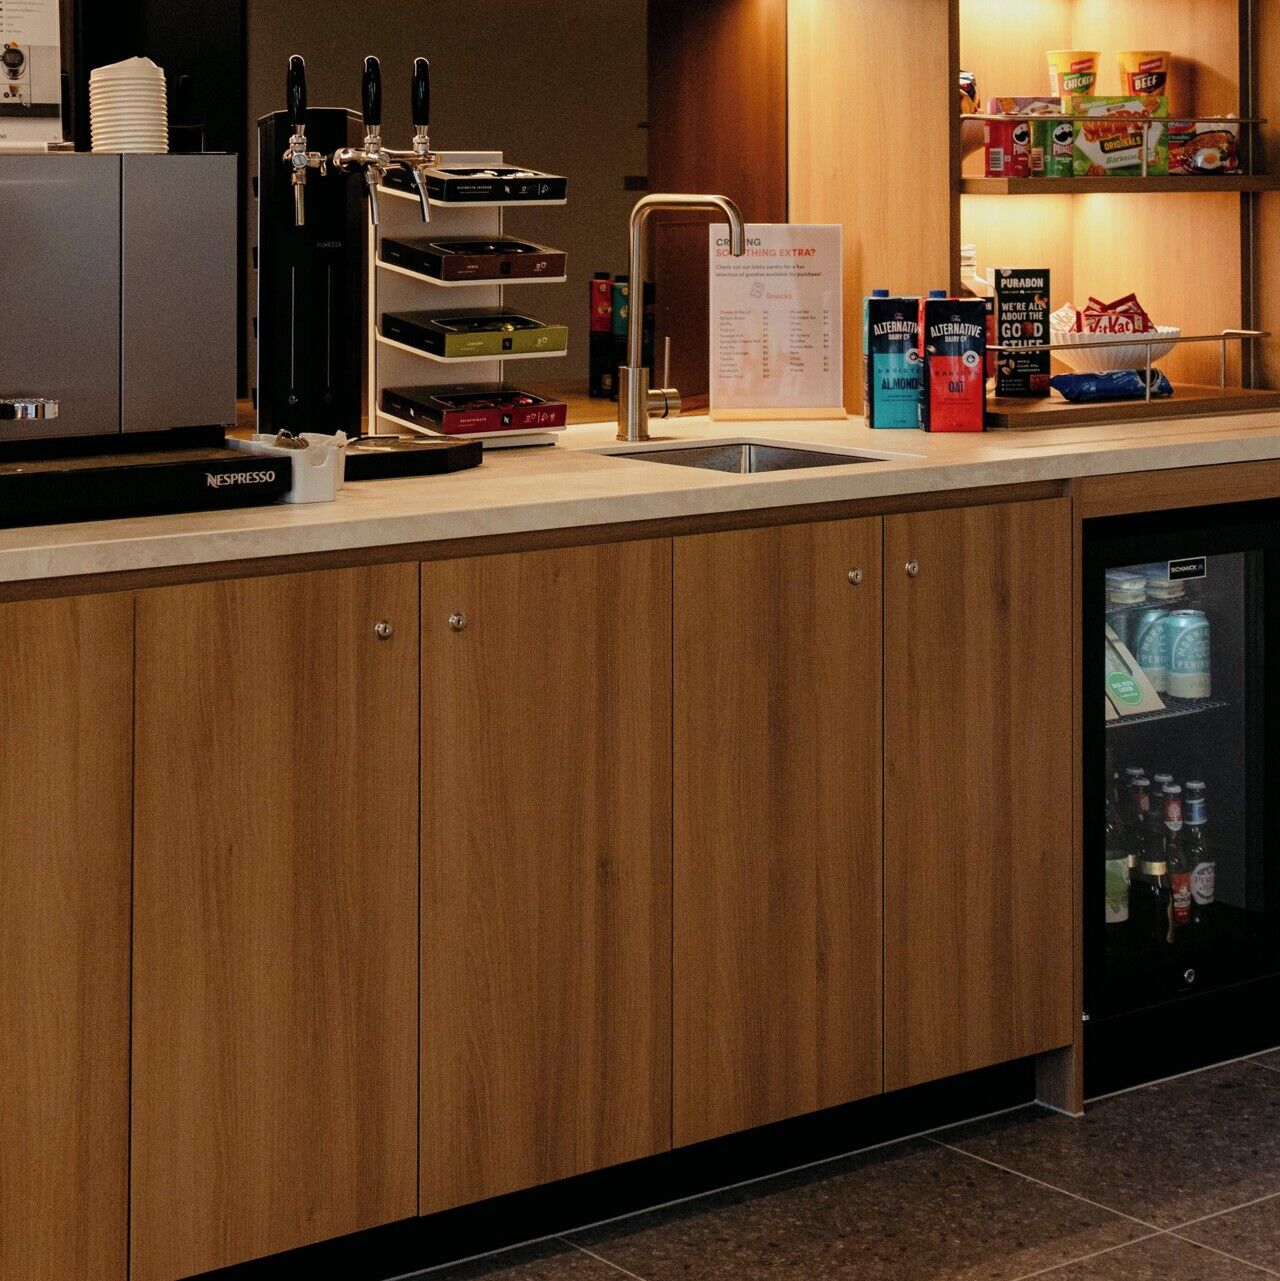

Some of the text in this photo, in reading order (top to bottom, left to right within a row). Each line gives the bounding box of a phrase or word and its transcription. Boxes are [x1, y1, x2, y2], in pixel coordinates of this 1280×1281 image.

[1063, 75, 1094, 91] CHICKEN
[1134, 75, 1158, 91] BEEF
[1104, 136, 1142, 151] ORIGINALS
[716, 238, 761, 247] CRNG
[716, 248, 816, 257] SOTHING EXTRA?
[1001, 302, 1043, 311] WE'RE ALL
[1001, 312, 1043, 320] ABOUT THE
[873, 321, 918, 336] ALTERNATIV
[930, 323, 982, 338] ALTERNATIVE
[881, 378, 918, 390] ALMOND
[948, 381, 966, 393] OAT
[205, 471, 276, 489] NESPRESSO
